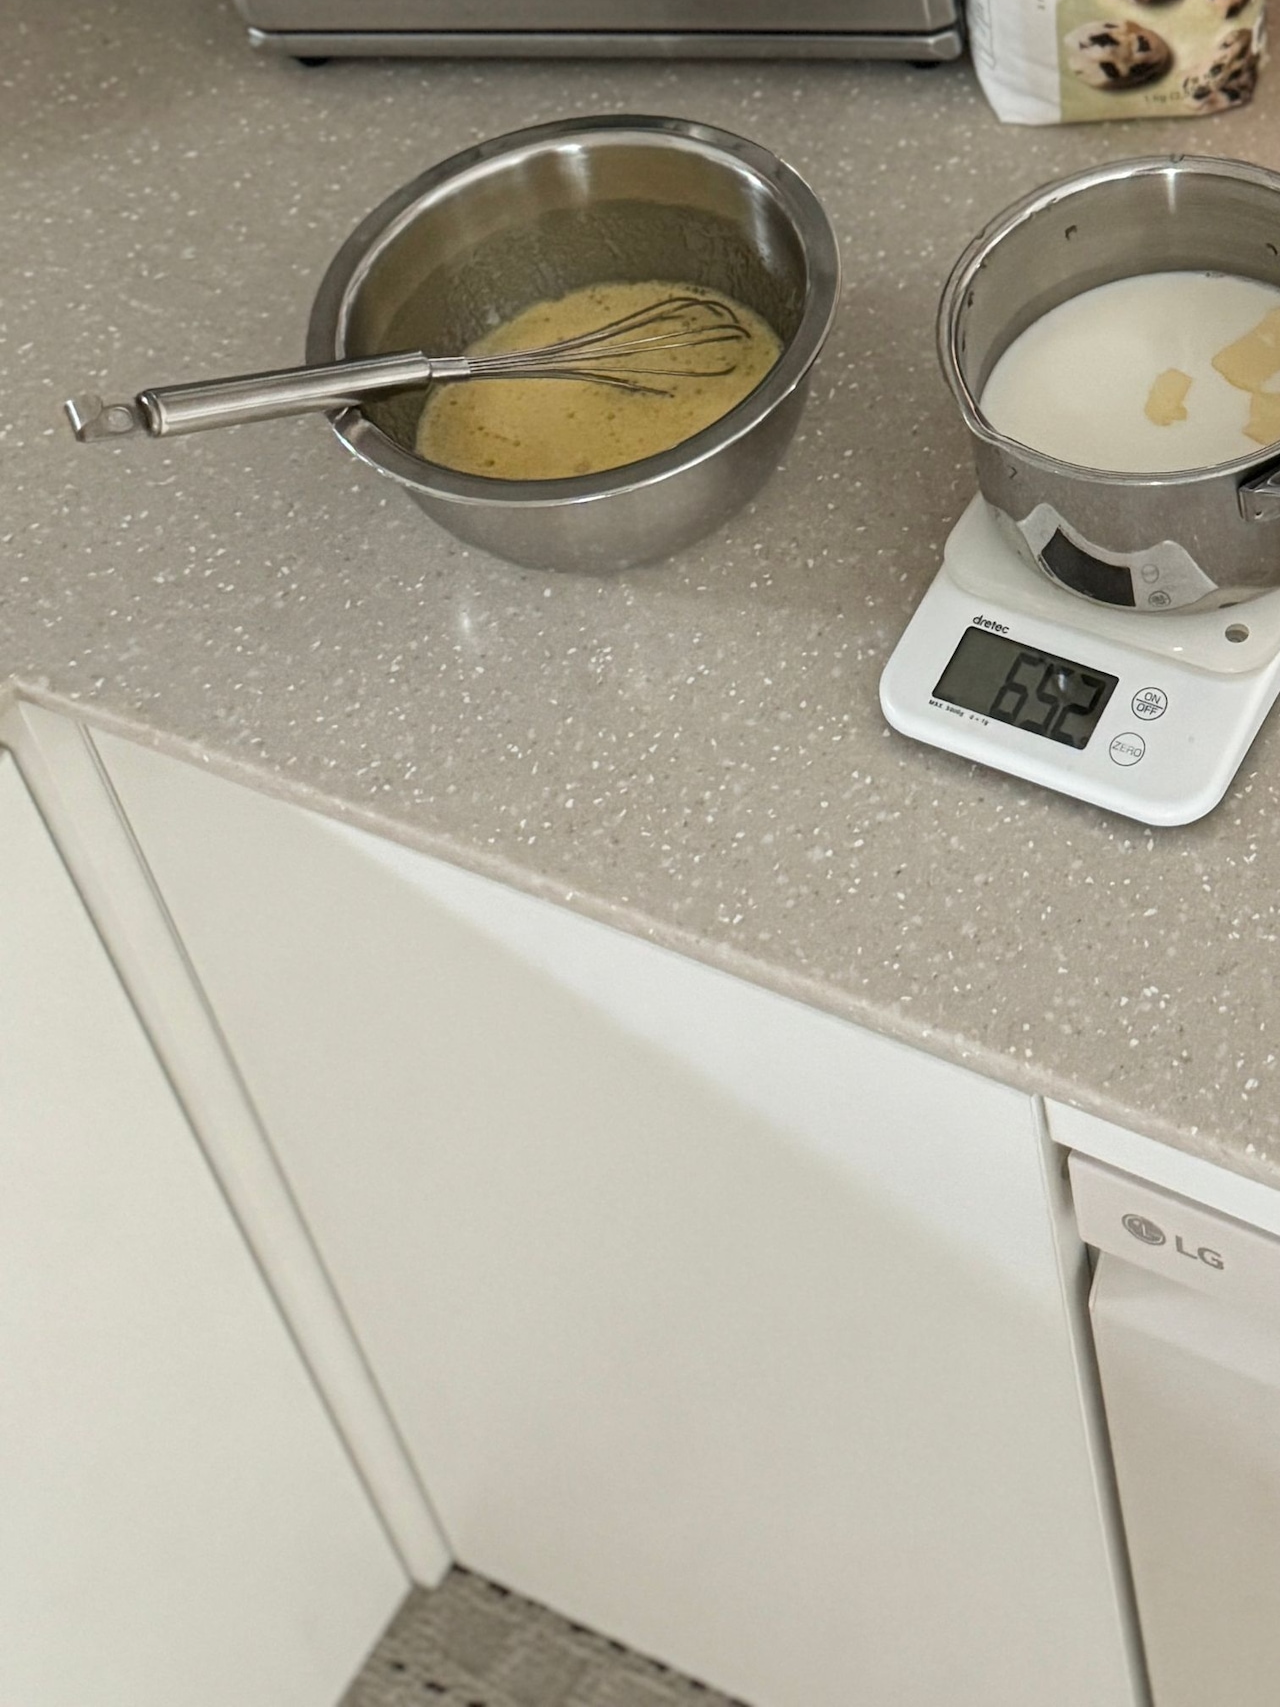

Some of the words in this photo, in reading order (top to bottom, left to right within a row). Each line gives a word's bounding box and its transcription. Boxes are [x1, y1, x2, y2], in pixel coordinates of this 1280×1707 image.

[972, 614, 1010, 634] dretec
[928, 699, 943, 709] MAX
[989, 652, 1106, 745] 652
[1144, 691, 1161, 705] ON
[1136, 703, 1159, 716] OFF
[1112, 741, 1142, 758] ZERO
[1176, 1235, 1224, 1270] LG
